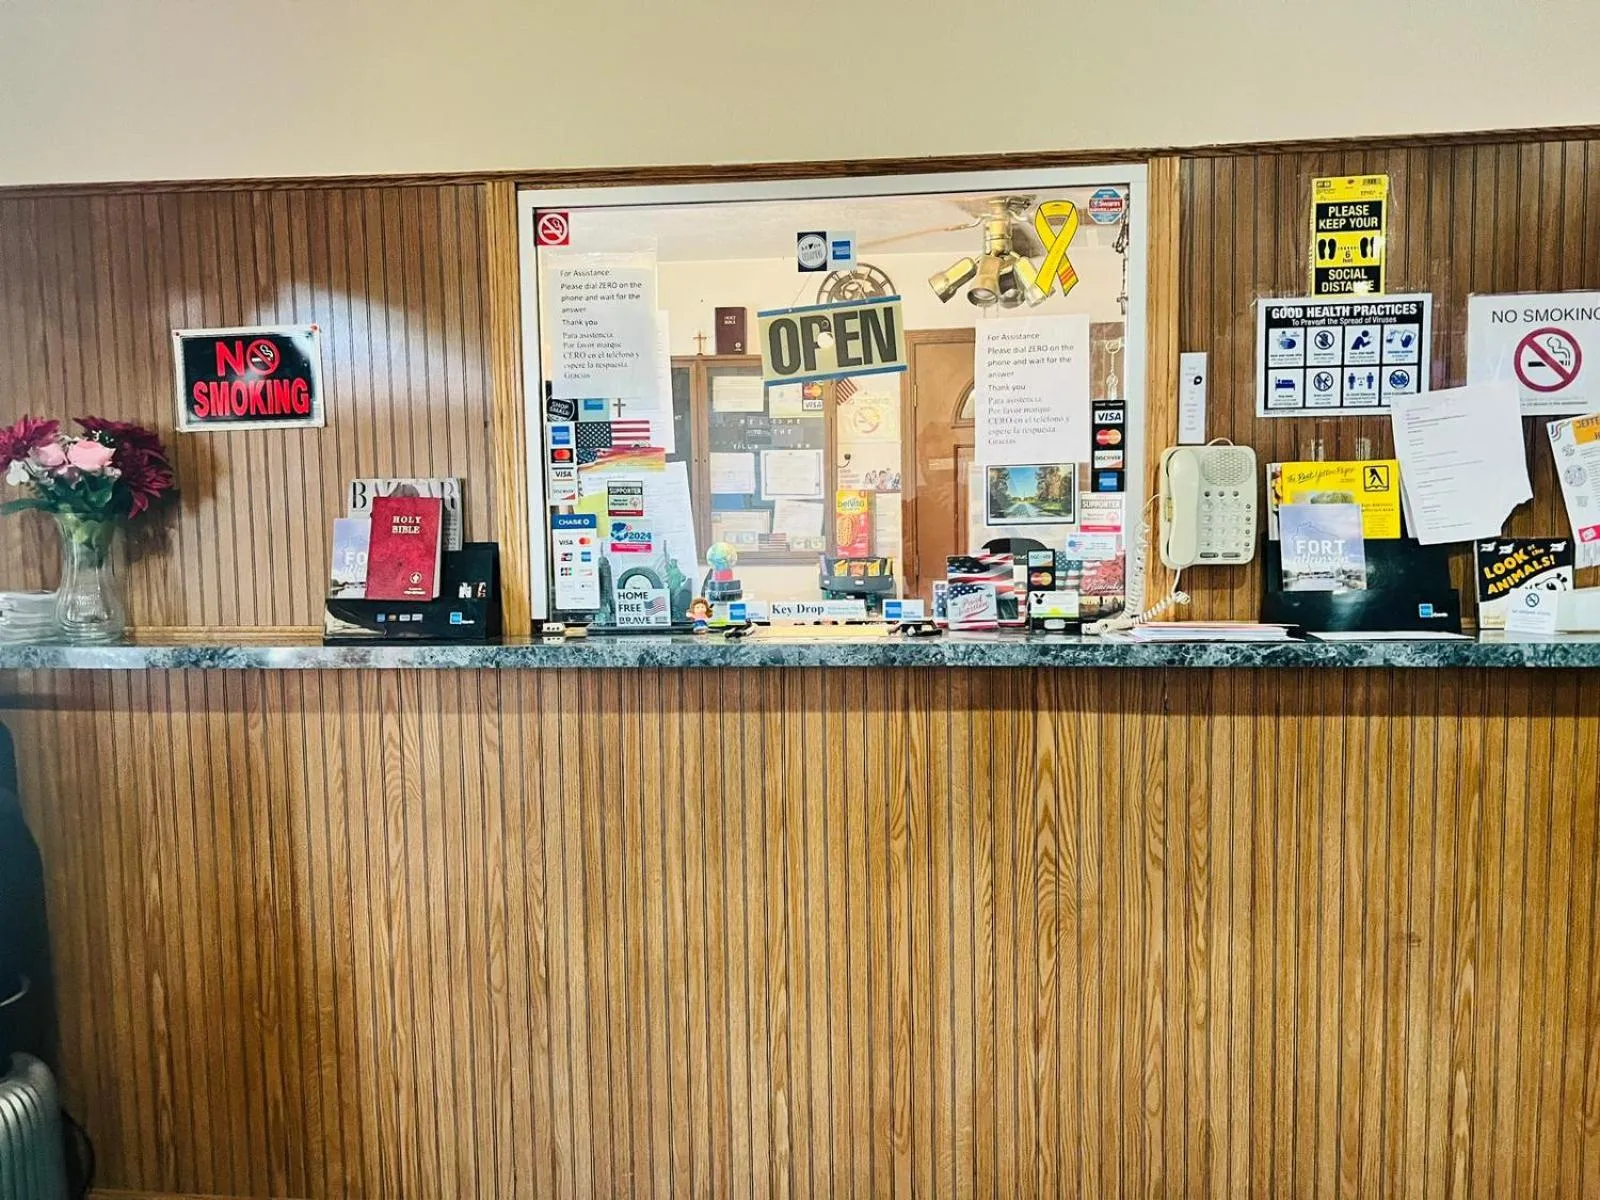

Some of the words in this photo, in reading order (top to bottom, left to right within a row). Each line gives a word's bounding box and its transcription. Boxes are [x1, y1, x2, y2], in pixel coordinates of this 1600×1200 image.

[1328, 205, 1370, 217] PLEASE
[1319, 218, 1346, 229] KEEP
[1349, 216, 1378, 228] YOUR
[1328, 268, 1368, 280] SOCIAL
[1321, 280, 1375, 292] DISTAE
[1272, 307, 1303, 319] GOOD
[1306, 306, 1351, 318] HEALTH
[1353, 304, 1418, 316] PRACTICES
[1492, 309, 1518, 323] NO
[1300, 318, 1326, 326] Prevent
[1340, 317, 1363, 326] Spread
[1364, 316, 1372, 324] of
[1372, 316, 1397, 324] Viruses
[768, 306, 898, 376] OPEN
[1012, 358, 1027, 366] and
[1012, 384, 1026, 392] you
[193, 377, 311, 418] SMOKING
[552, 401, 570, 410] SHOP
[1098, 412, 1122, 421] VISA
[392, 515, 422, 524] HOLY
[558, 518, 582, 526] CHASE
[392, 525, 420, 534] BIBLE
[628, 532, 652, 540] 2024
[1296, 540, 1346, 555] FORT
[1531, 548, 1544, 556] the
[1484, 548, 1530, 579] LOOK
[1488, 554, 1556, 595] ANIMALS!
[618, 592, 648, 600] HOME
[618, 604, 641, 612] FREE
[772, 604, 792, 616] Key
[796, 604, 825, 615] Drop
[618, 616, 650, 624] BRAVE
